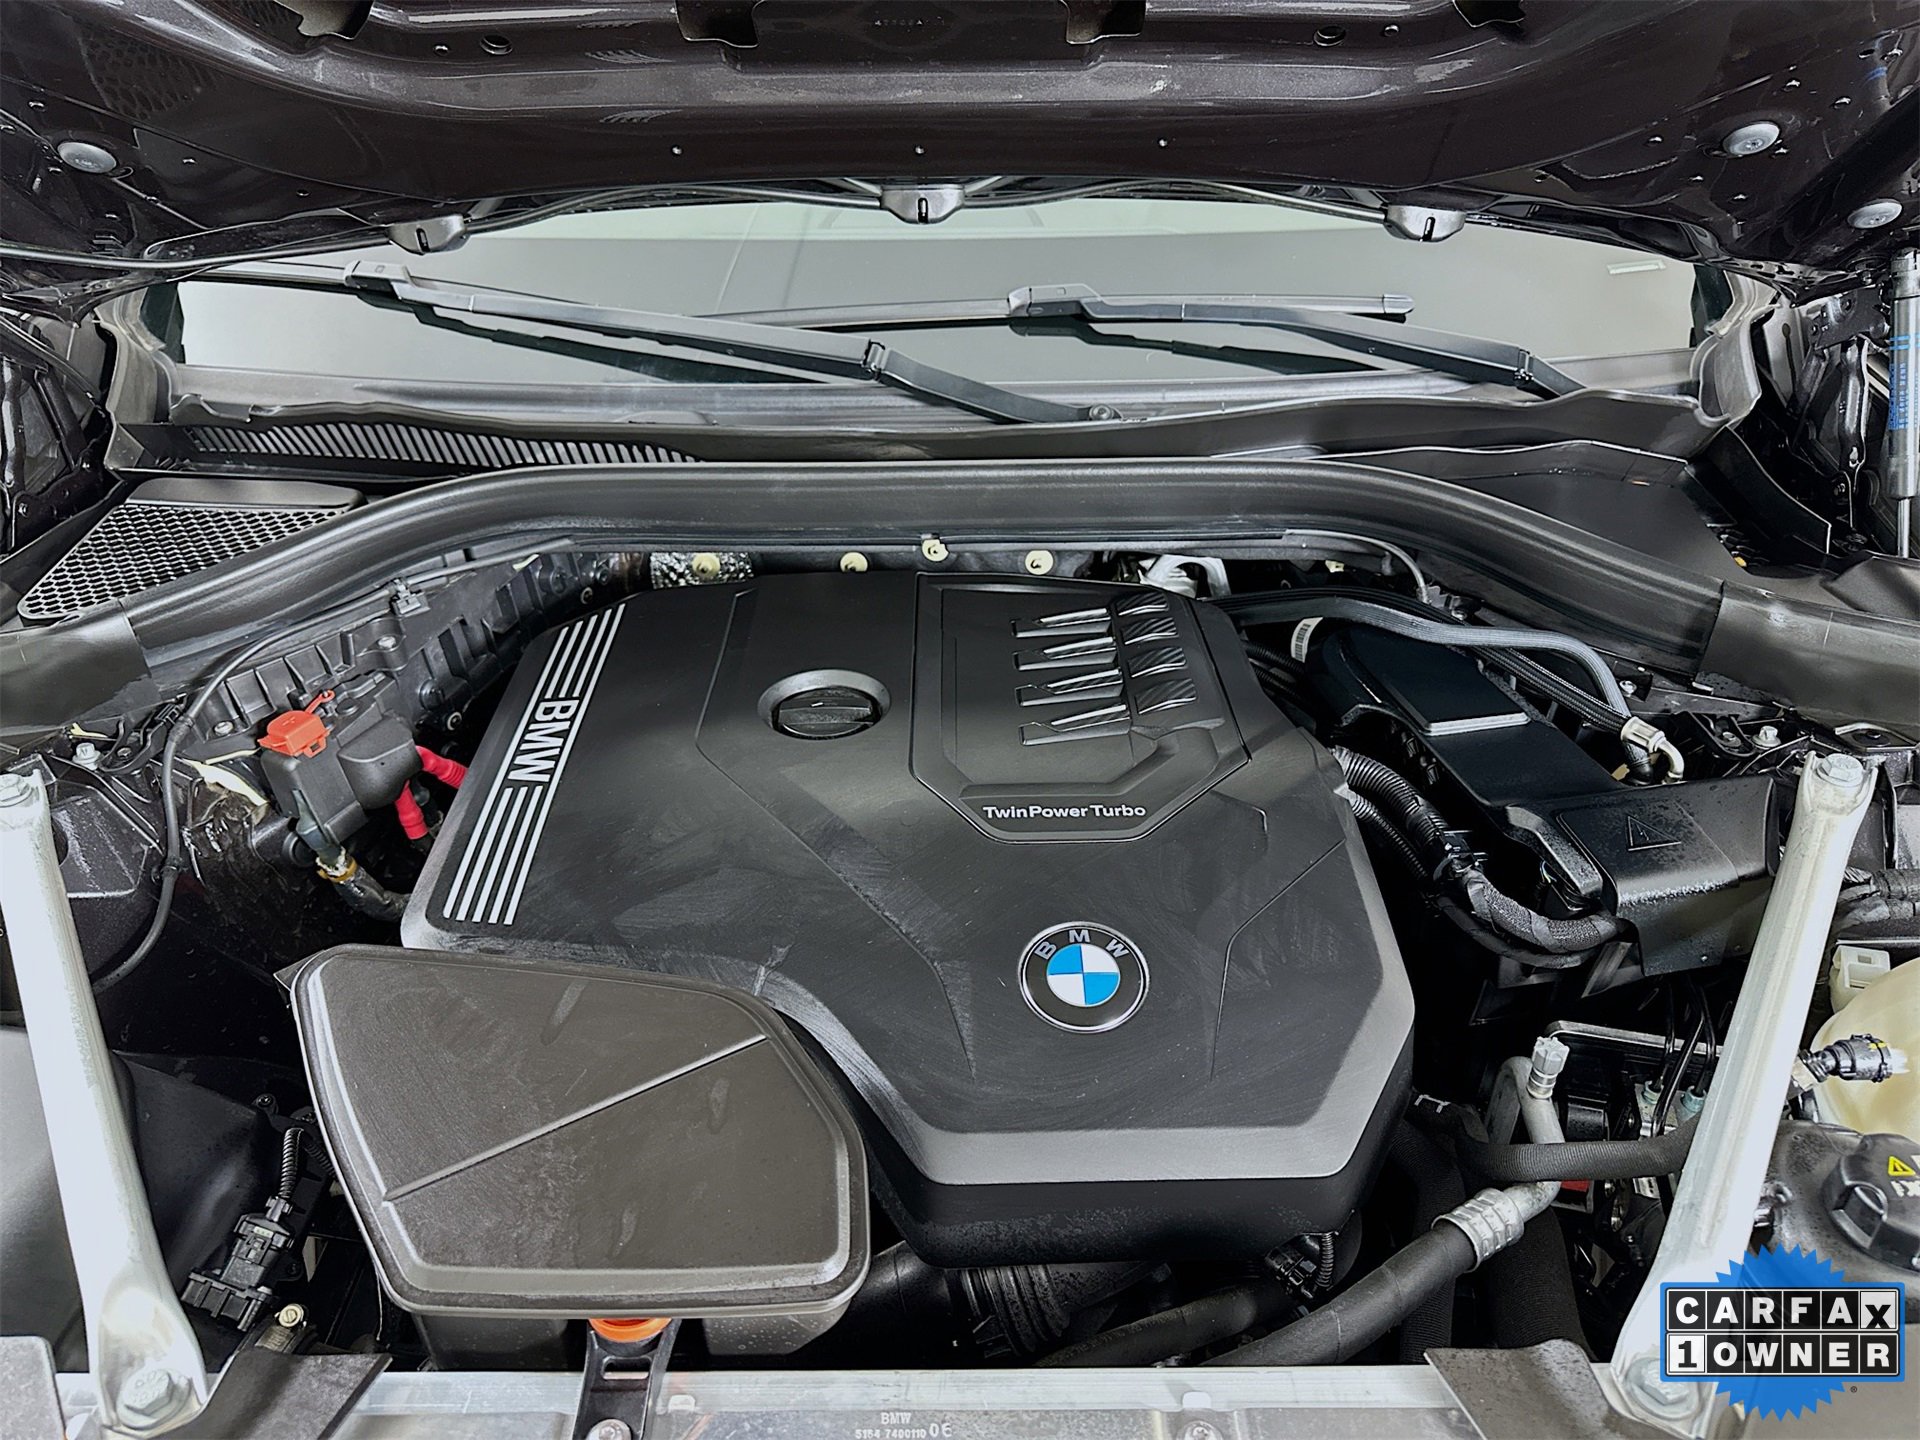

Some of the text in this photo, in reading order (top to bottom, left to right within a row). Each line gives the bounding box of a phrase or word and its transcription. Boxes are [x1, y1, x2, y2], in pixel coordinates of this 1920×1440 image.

[507, 699, 580, 783] BMW
[982, 804, 1147, 819] TwinPower Turbo
[1034, 928, 1130, 960] BMW
[880, 1411, 912, 1425] BMW
[884, 1428, 927, 1439] 7400110
